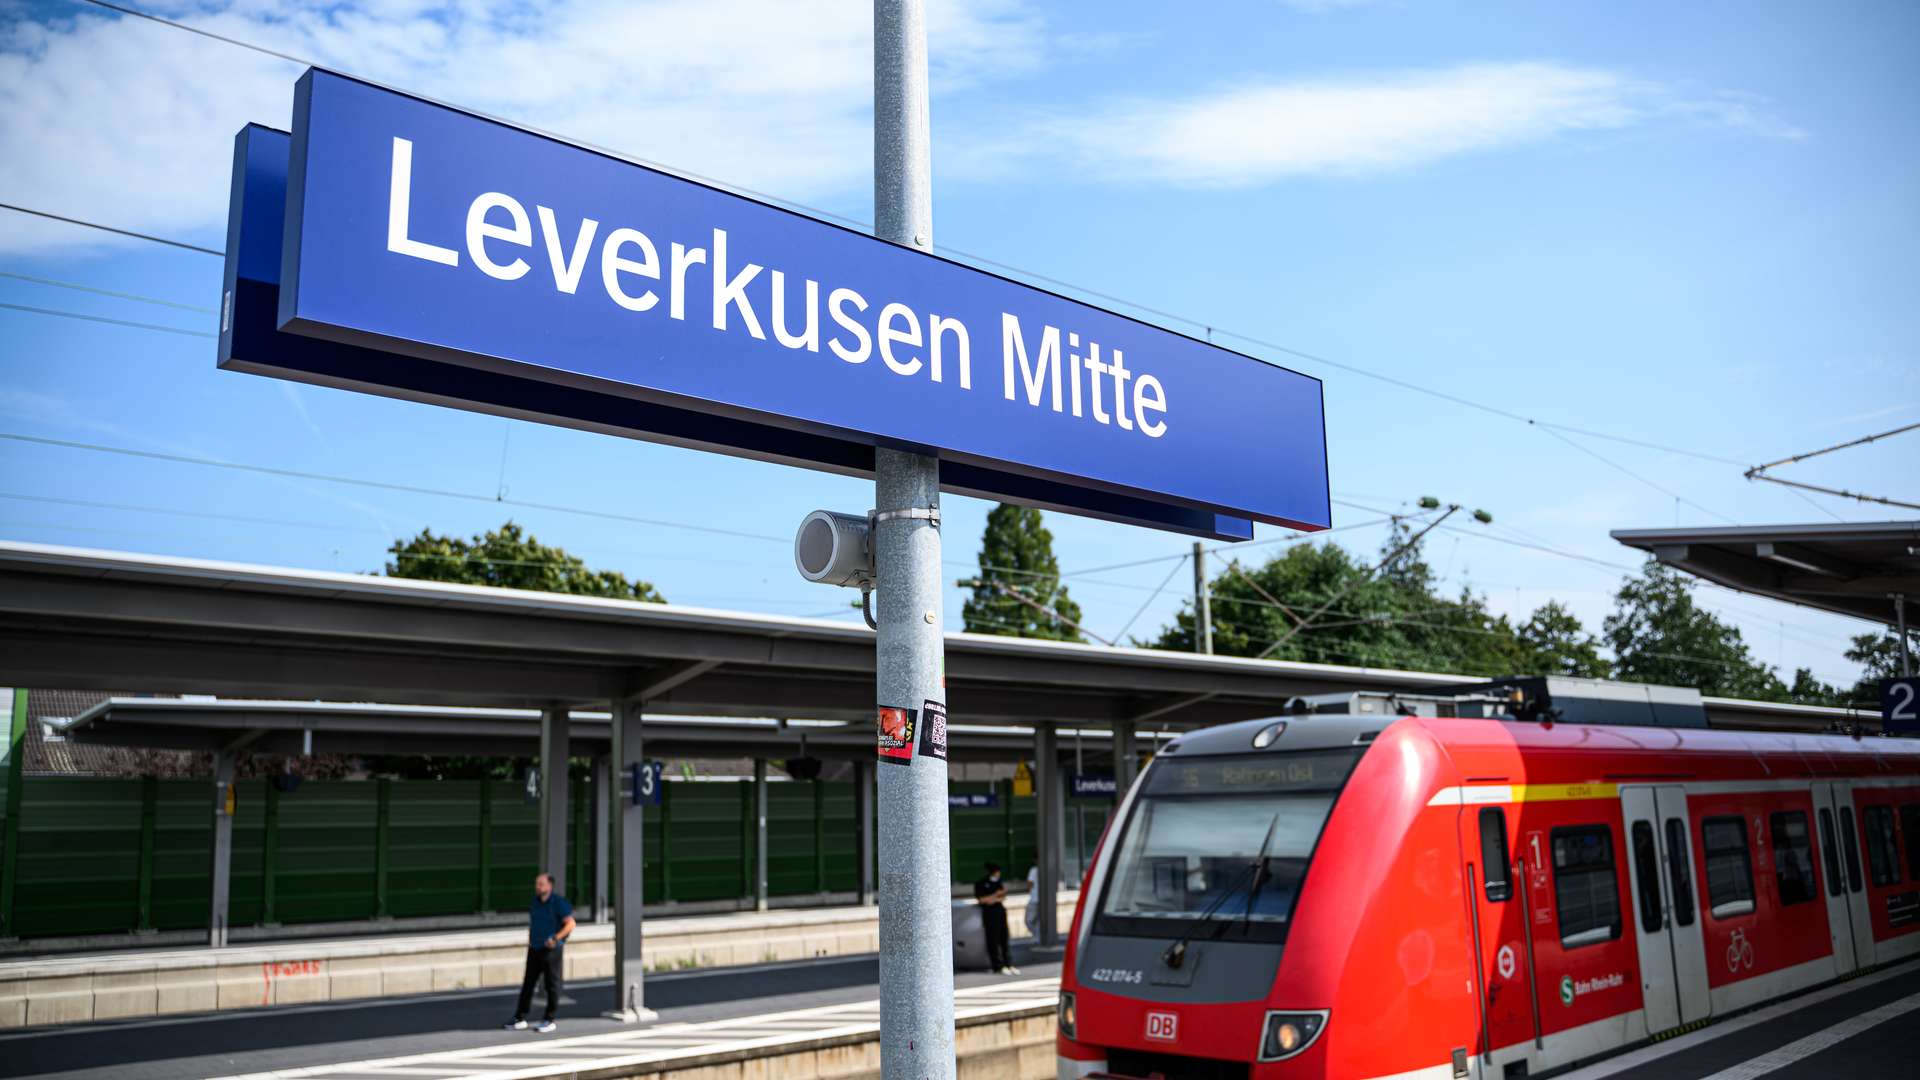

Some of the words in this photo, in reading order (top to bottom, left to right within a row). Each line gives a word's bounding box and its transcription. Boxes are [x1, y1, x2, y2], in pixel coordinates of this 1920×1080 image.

[387, 136, 972, 391] Leverkusen
[1002, 312, 1168, 438] Mitte
[1889, 682, 1916, 720] 2
[527, 769, 537, 798] 4
[642, 764, 654, 796] 3
[1530, 833, 1542, 870] 1
[1149, 1014, 1175, 1037] DB
